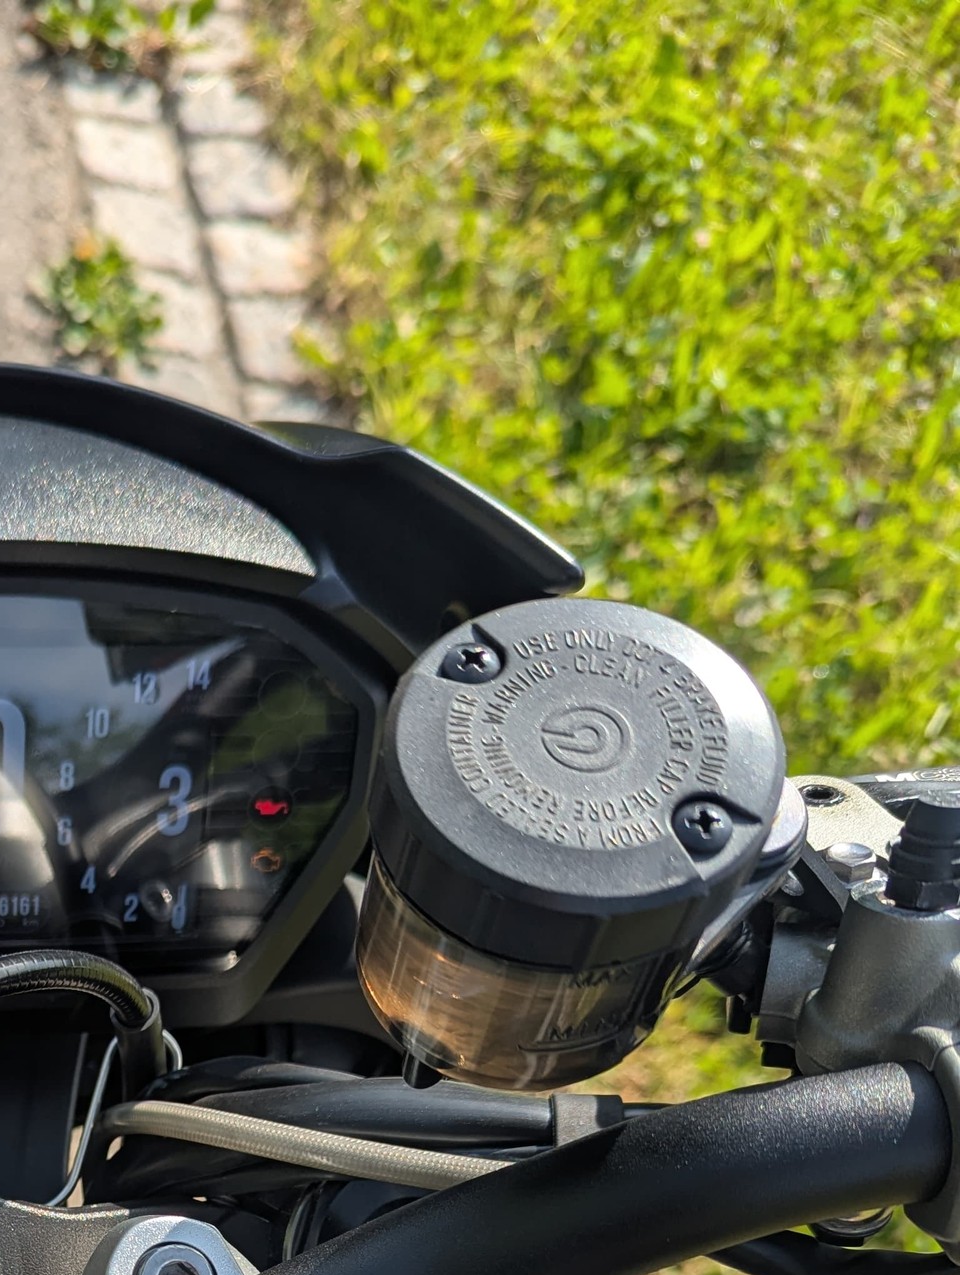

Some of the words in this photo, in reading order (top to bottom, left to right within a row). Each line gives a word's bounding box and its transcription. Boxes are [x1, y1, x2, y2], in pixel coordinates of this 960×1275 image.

[186, 660, 212, 691] 14
[573, 653, 648, 688] CLEAN
[132, 672, 158, 703] 12
[85, 708, 110, 739] 10
[512, 630, 560, 659] USE
[563, 629, 618, 652] ONLY
[695, 735, 728, 787] FLUID
[59, 760, 74, 792] 8
[655, 756, 691, 796] CAP
[157, 763, 193, 838] 3
[573, 786, 660, 823] BEFORE
[56, 817, 72, 847] 6
[81, 866, 96, 894] 4
[124, 893, 139, 922] 2
